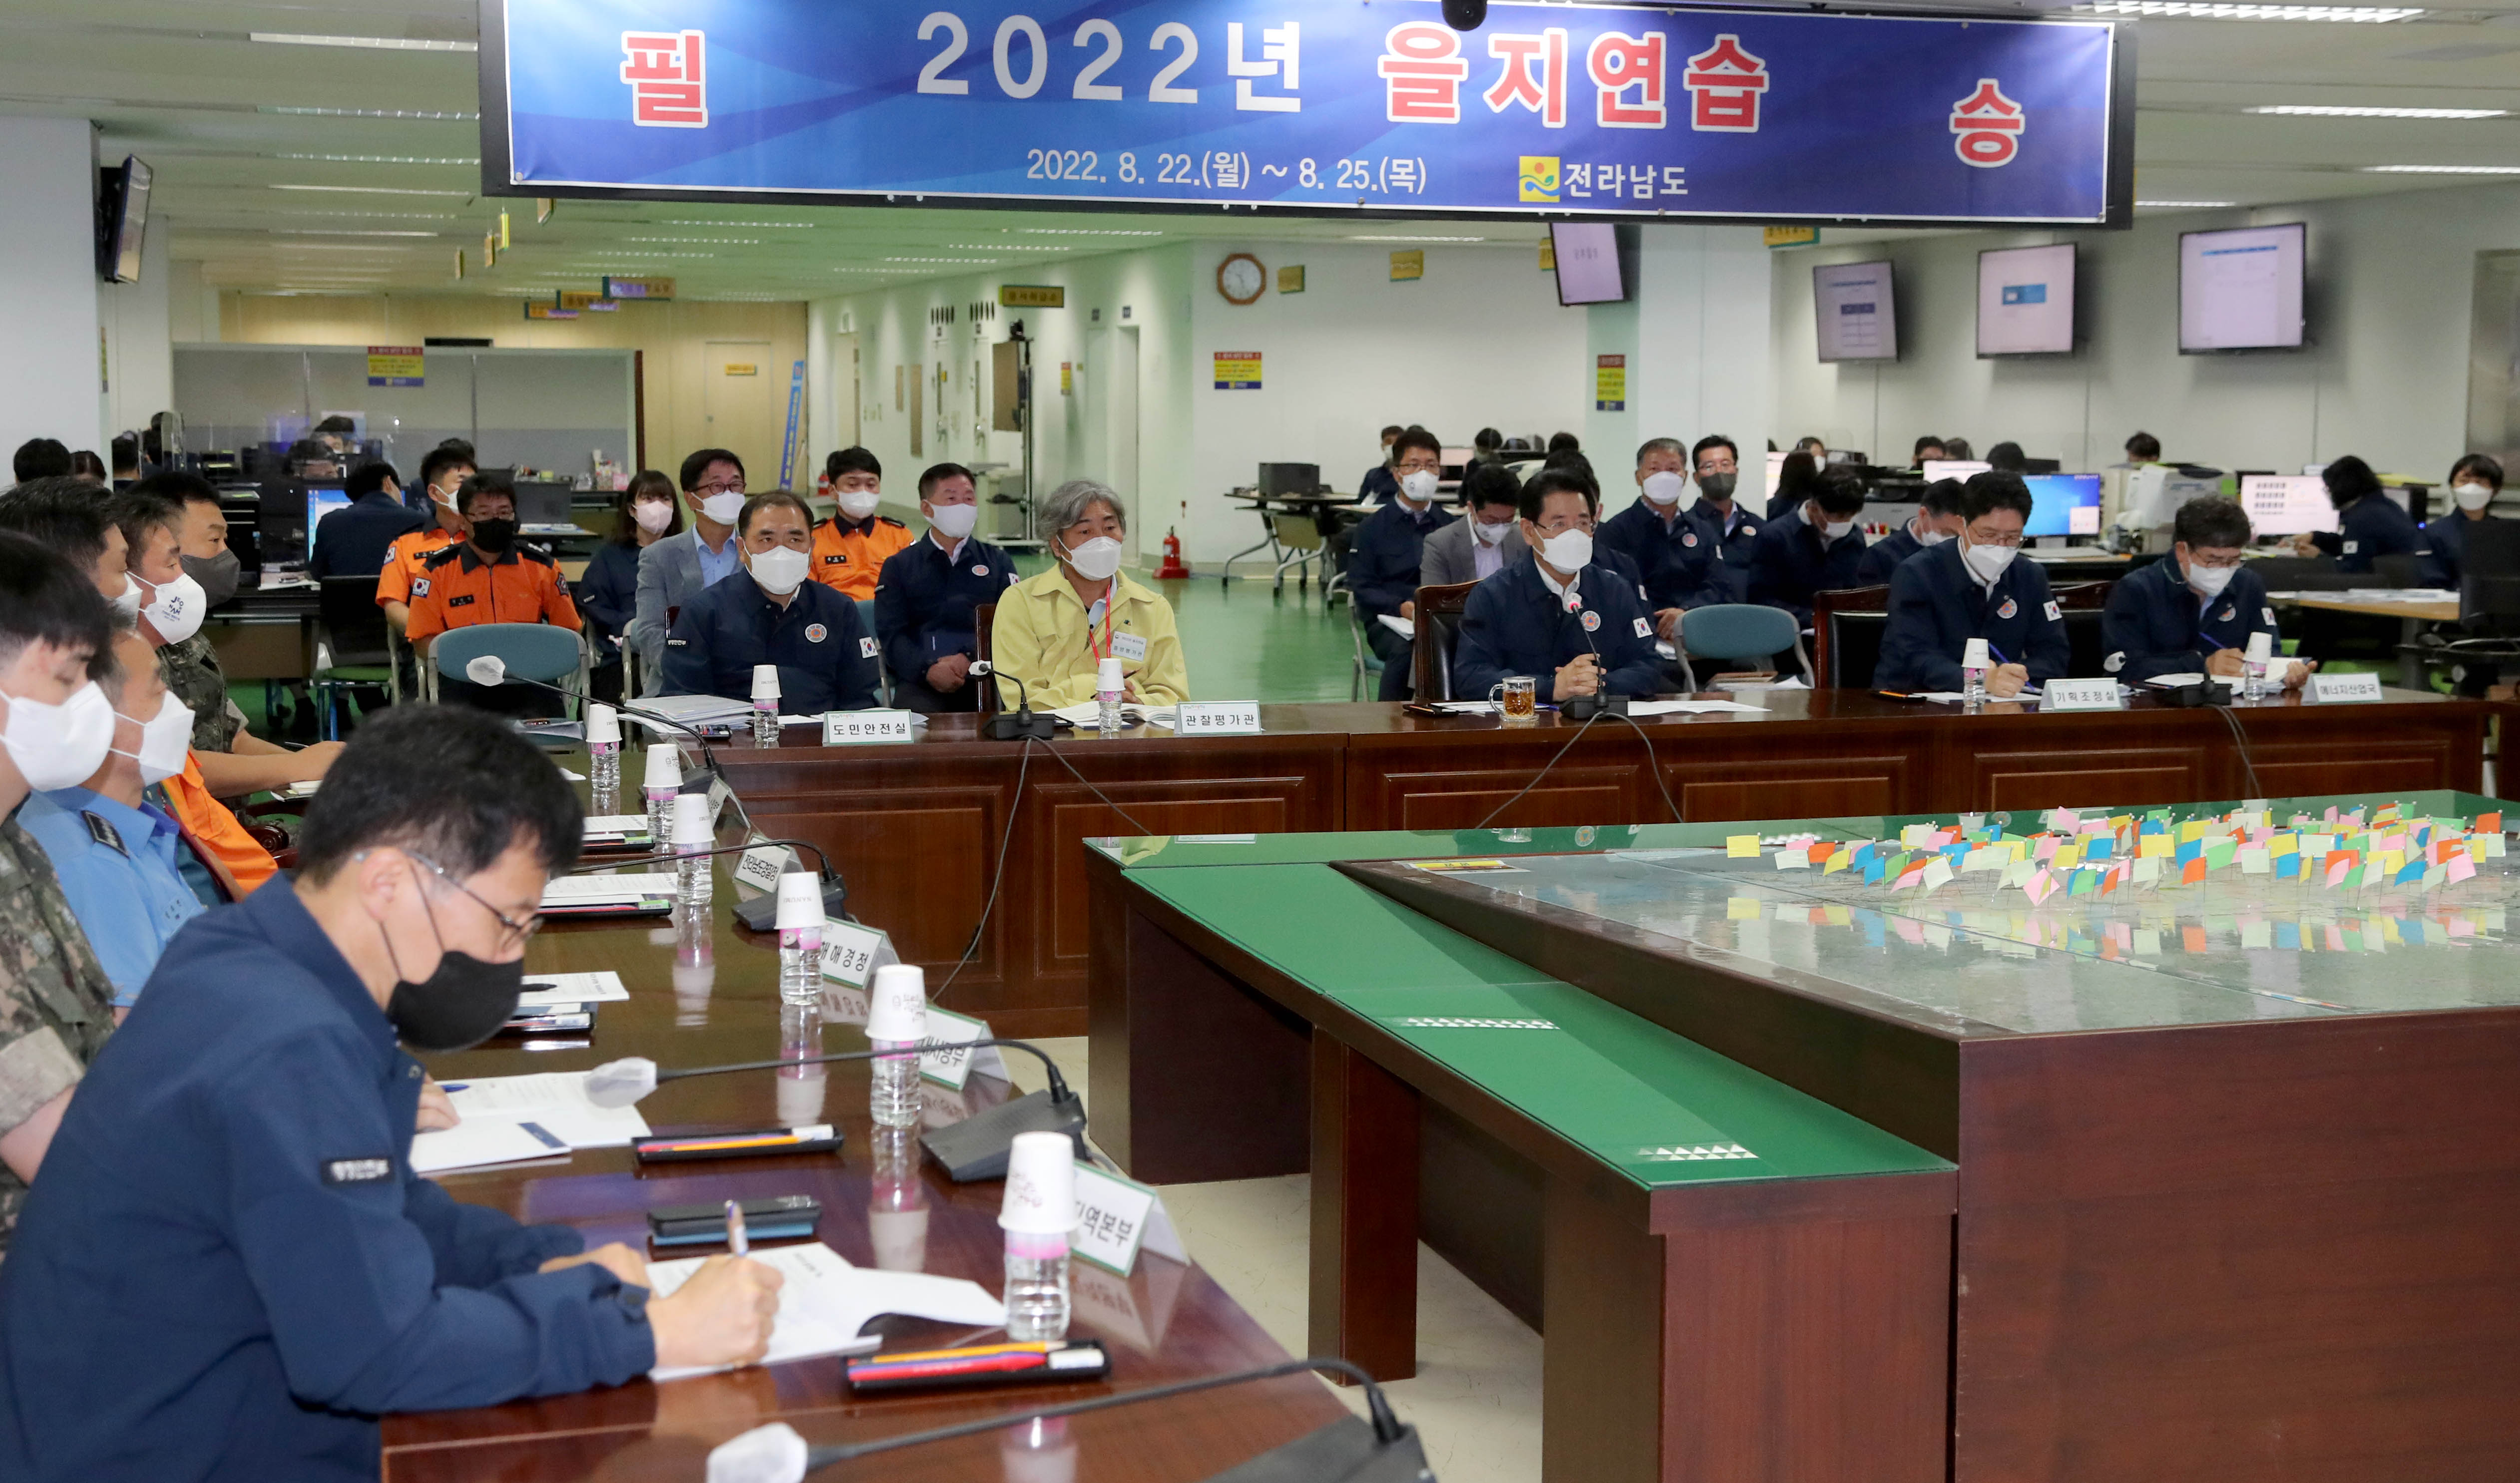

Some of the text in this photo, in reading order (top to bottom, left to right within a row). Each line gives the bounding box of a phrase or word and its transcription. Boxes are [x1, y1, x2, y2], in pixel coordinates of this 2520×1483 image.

[621, 30, 708, 128] 필
[917, 11, 1769, 132] 2022년 을지연습
[1950, 79, 2025, 167] 승
[1027, 149, 1107, 182] 2022.
[1119, 154, 1144, 184] 8.
[1157, 151, 1250, 190] 22.(월)
[1299, 157, 1324, 189] 8.
[1336, 156, 1426, 195] 25.(목)
[1564, 163, 1687, 199] 전라남도
[2055, 691, 2114, 703] 기획조정실
[2320, 684, 2376, 696] 에너지산업국
[834, 723, 906, 736] 도민안전실
[1186, 714, 1254, 726] 관찰평가관
